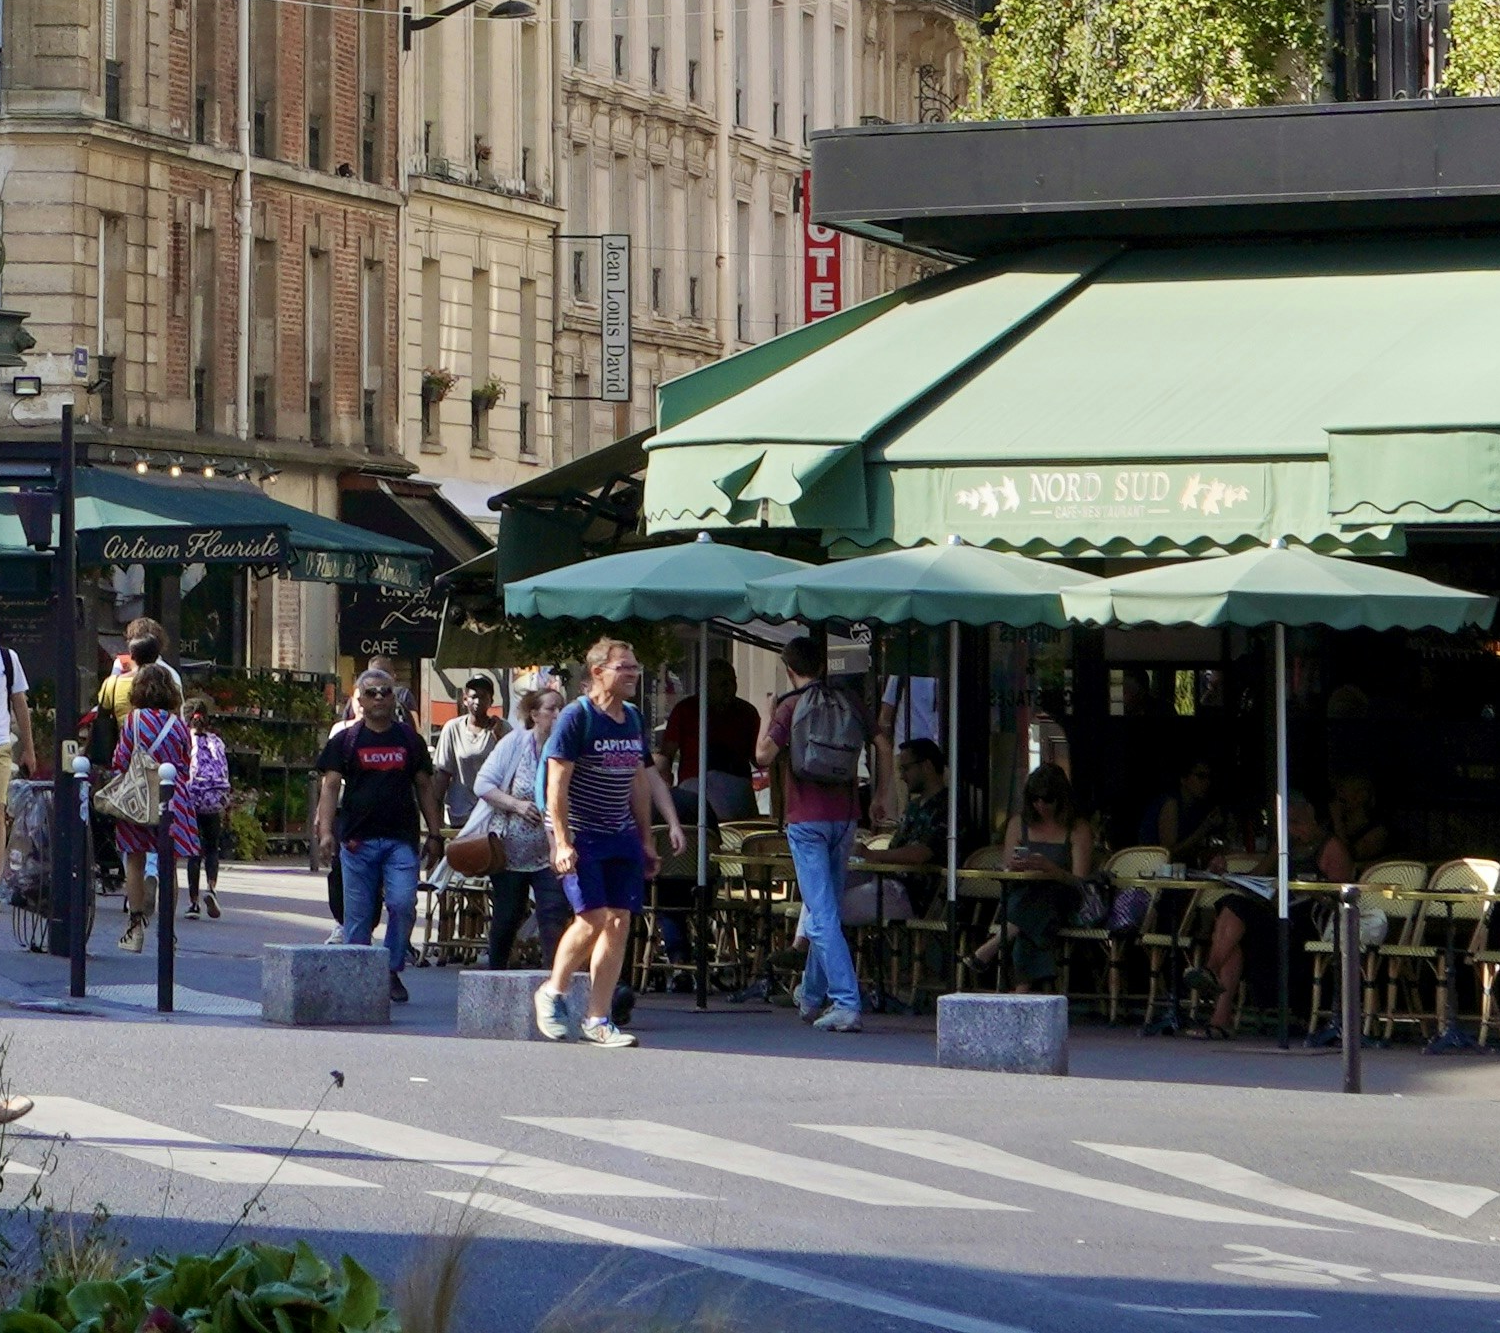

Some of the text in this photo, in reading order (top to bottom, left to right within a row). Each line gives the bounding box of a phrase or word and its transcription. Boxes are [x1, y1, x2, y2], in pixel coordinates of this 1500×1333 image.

[807, 222, 836, 324] OTE
[606, 242, 626, 394] Jean Louis David
[1029, 471, 1170, 503] NORD SUD
[103, 529, 281, 560] Artisan Fleuriste
[361, 637, 399, 655] CAFÉ
